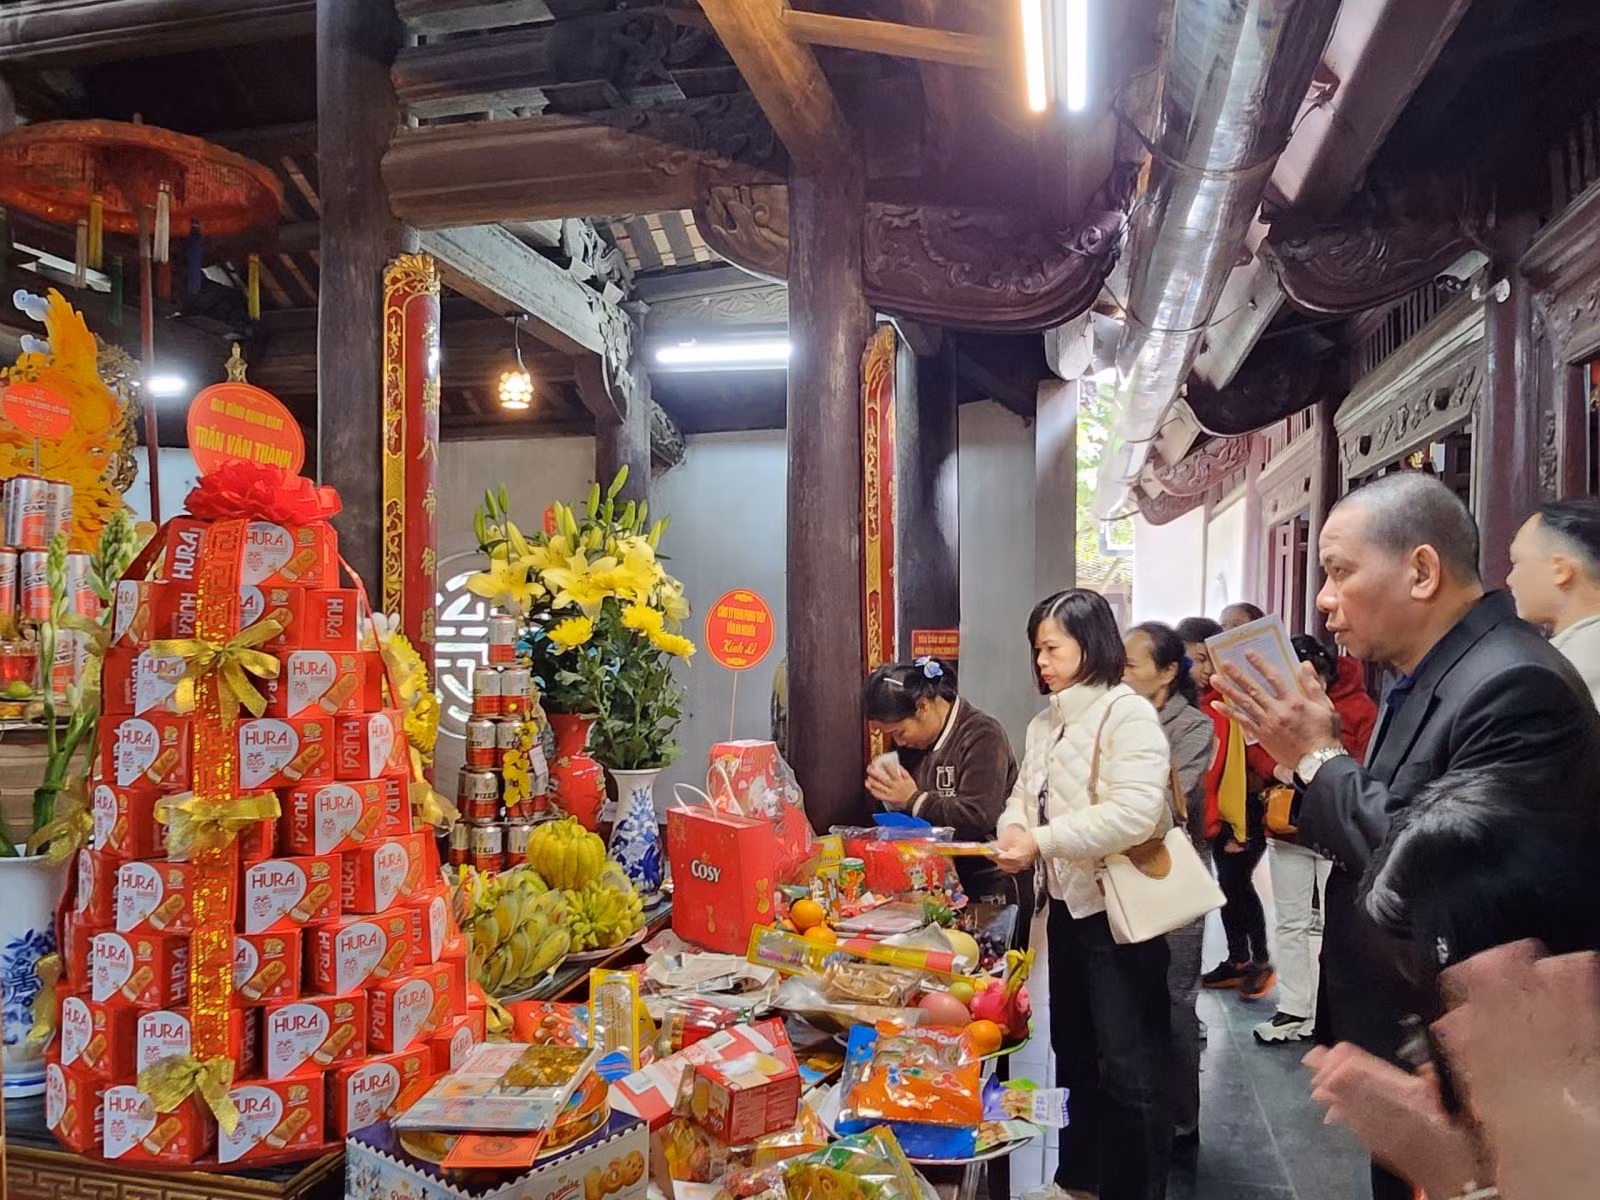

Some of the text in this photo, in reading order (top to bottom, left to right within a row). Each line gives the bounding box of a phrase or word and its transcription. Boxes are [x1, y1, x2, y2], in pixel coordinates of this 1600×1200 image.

[196, 423, 225, 453] TRẦN
[226, 433, 253, 460] VĂN
[246, 532, 283, 546] HURA
[172, 531, 199, 580] HURA
[178, 592, 196, 634] HURA
[326, 598, 344, 639] HURA
[293, 661, 328, 675] HURA
[122, 729, 153, 745] HURA
[245, 730, 287, 746] HURA
[342, 721, 360, 769] HURA
[96, 795, 113, 809] HURA
[320, 794, 354, 812] HURA
[386, 780, 401, 826] HURA
[294, 792, 308, 846] HURA
[378, 853, 402, 869] HURA
[252, 871, 295, 889] HURA
[690, 860, 721, 883] COSY
[121, 874, 155, 891] HURA
[342, 859, 356, 909] HURA
[96, 943, 126, 961] HURA
[341, 933, 377, 952] HURA
[317, 931, 331, 983] HURA
[170, 946, 188, 1001] HURA
[398, 988, 426, 1005] HURA
[65, 1008, 87, 1025] HURA
[274, 1013, 318, 1033] HURA
[371, 990, 386, 1041] HURA
[143, 1023, 184, 1039] HURA
[352, 1072, 390, 1095] HURA
